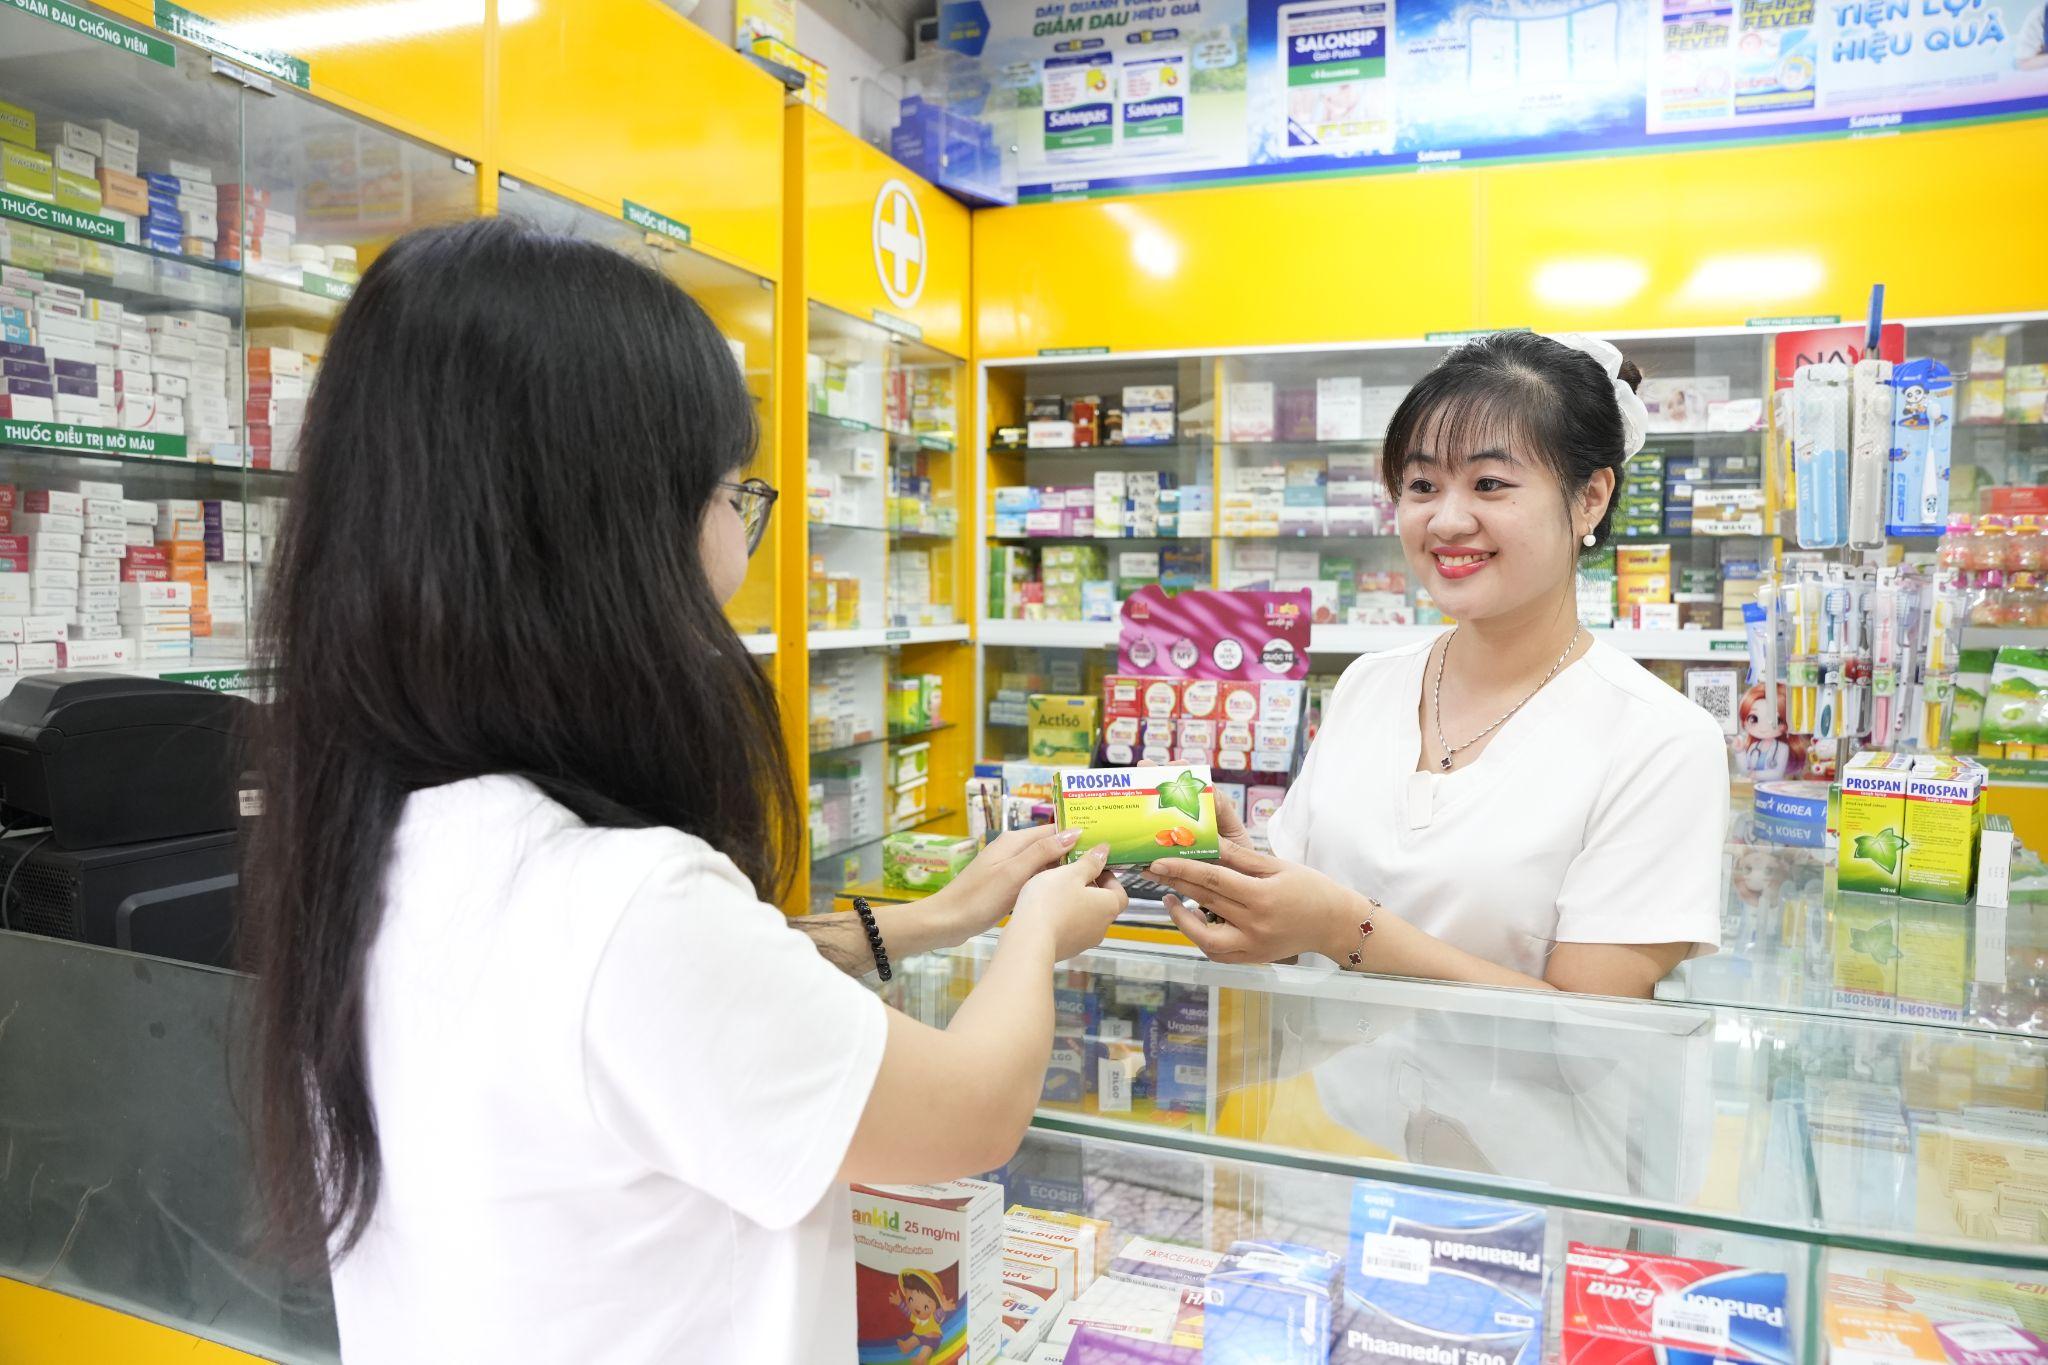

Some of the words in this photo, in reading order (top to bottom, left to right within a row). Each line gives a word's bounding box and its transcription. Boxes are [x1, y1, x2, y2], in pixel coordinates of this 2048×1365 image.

[52, 7, 76, 27] ĐAU
[79, 19, 121, 44] CHỐNG
[123, 35, 149, 55] VIÊM
[1033, 17, 1084, 37] GIẢM
[1089, 11, 1131, 30] ĐAU
[1295, 29, 1378, 53] SALONSIP
[1831, 33, 1914, 64] HIỆU
[1924, 13, 2006, 51] QUẢ
[1048, 108, 1109, 127] Salonpas
[1126, 101, 1180, 118] Salonpas
[1, 197, 48, 219] THUỐC
[51, 210, 73, 226] TIM
[76, 217, 115, 237] MẠCH
[5, 423, 52, 442] THUỐC
[55, 426, 83, 444] ĐIỀU
[86, 433, 104, 450] TRỊ
[129, 436, 155, 451] MÁU
[1066, 773, 1131, 790] PROSPAN
[1846, 777, 1901, 792] PROSPAN
[1910, 782, 1968, 798] PROSPAN
[1776, 802, 1812, 817] KOREA
[904, 1220, 919, 1233] 25
[921, 1225, 960, 1242] mg/ml
[1433, 1239, 1541, 1273] Phaanedol
[1586, 1281, 1656, 1306] Extra
[1347, 1330, 1460, 1364] Phaanedol
